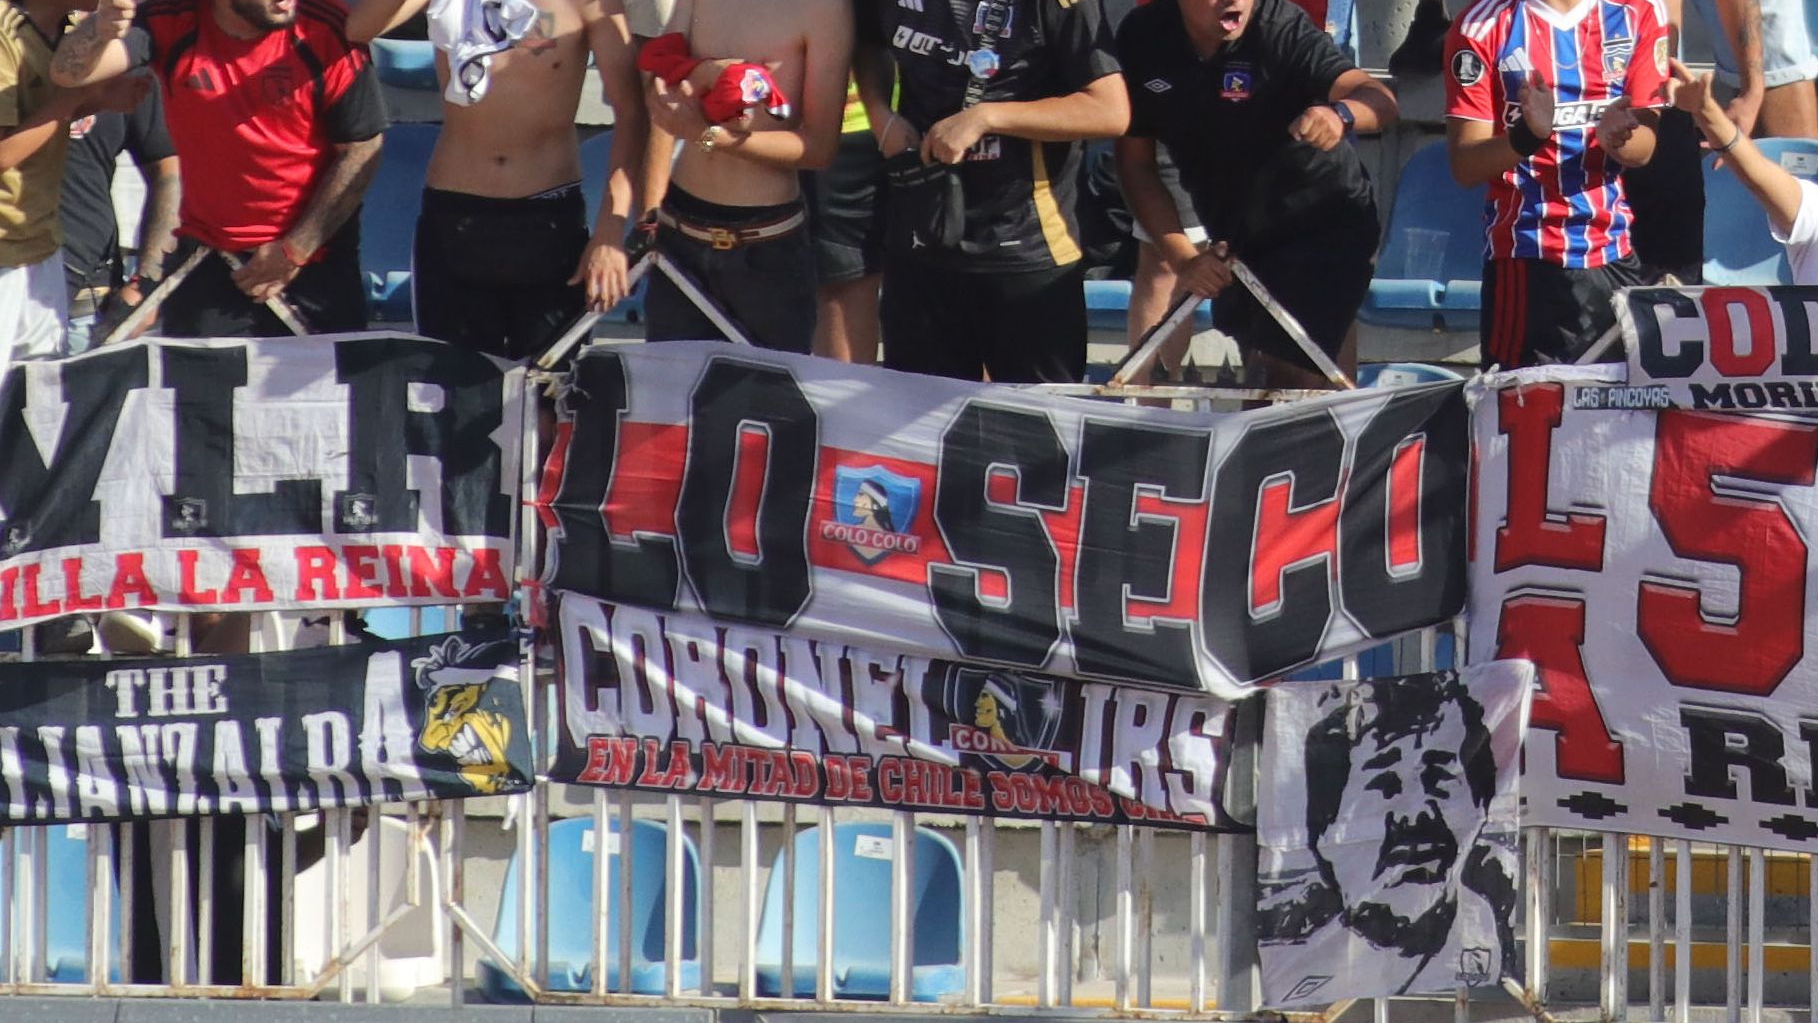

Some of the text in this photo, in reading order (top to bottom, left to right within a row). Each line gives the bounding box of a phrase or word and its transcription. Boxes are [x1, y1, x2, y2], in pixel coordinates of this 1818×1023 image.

[1573, 385, 1600, 409] LAS
[822, 523, 918, 554] COLO COLO
[926, 380, 1471, 687] SECO
[178, 548, 274, 606] LA
[294, 544, 511, 604] REINA
[106, 663, 229, 718] THE
[578, 737, 638, 785] EN
[636, 738, 696, 790] LA
[696, 743, 819, 799] MITAD
[824, 754, 874, 803] DE
[878, 757, 985, 810] CHILE
